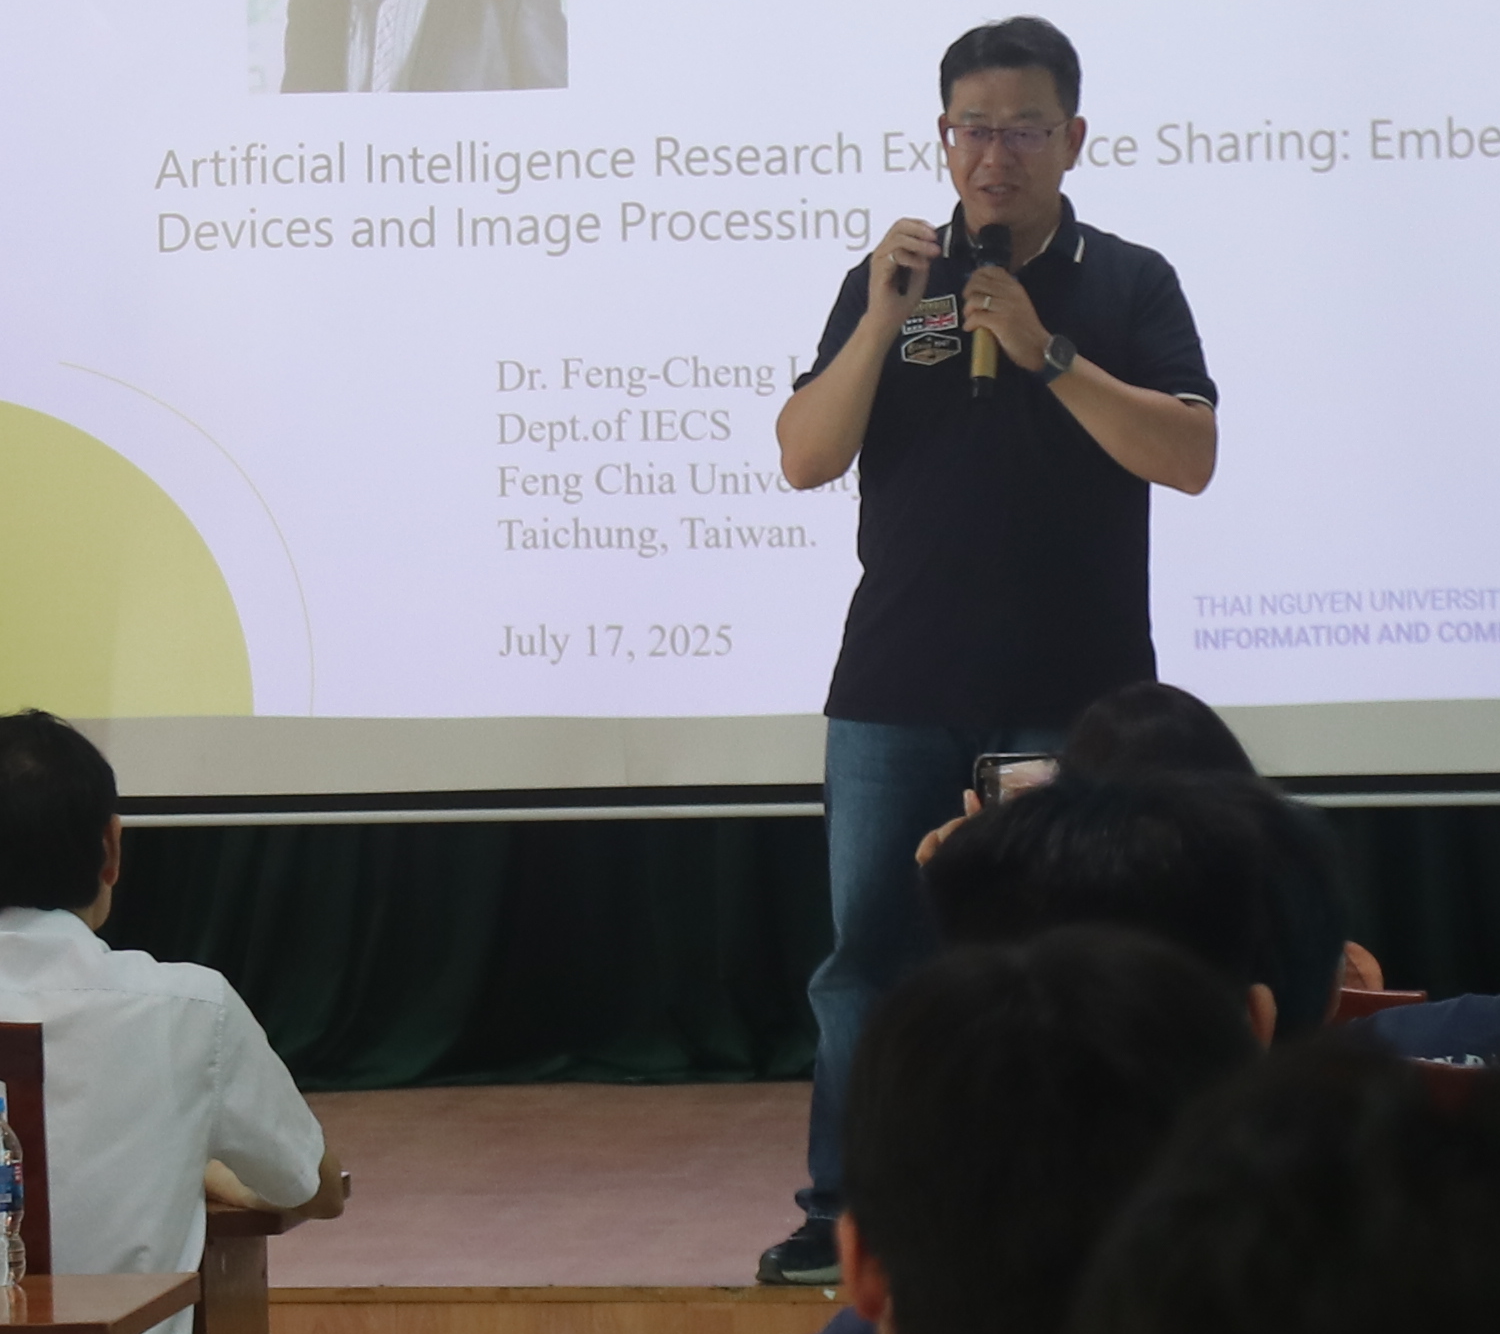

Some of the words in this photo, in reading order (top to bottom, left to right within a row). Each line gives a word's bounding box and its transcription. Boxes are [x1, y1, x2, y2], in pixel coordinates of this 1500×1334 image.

[155, 141, 345, 189] Artificial
[367, 141, 635, 194] Intelligence
[656, 132, 861, 176] Research
[1157, 120, 1349, 173] Sharing:
[157, 209, 333, 253] Devices
[352, 206, 435, 248] and
[458, 208, 600, 257] Image
[621, 200, 872, 251] Processing
[498, 361, 546, 391] Dr.
[563, 356, 775, 397] Feng-Cheng
[641, 410, 731, 441] IECS
[499, 466, 583, 504] Feng
[595, 462, 676, 494] Chia
[498, 517, 668, 558] Taichung,
[680, 516, 816, 549] Taiwan.
[1194, 595, 1252, 617] THAI
[1260, 591, 1362, 615] NGUYEN
[499, 624, 569, 665] July
[588, 625, 634, 660] 17,
[649, 624, 732, 657] 2025
[1194, 623, 1370, 649] INFORMATION
[1378, 621, 1431, 644] AND
